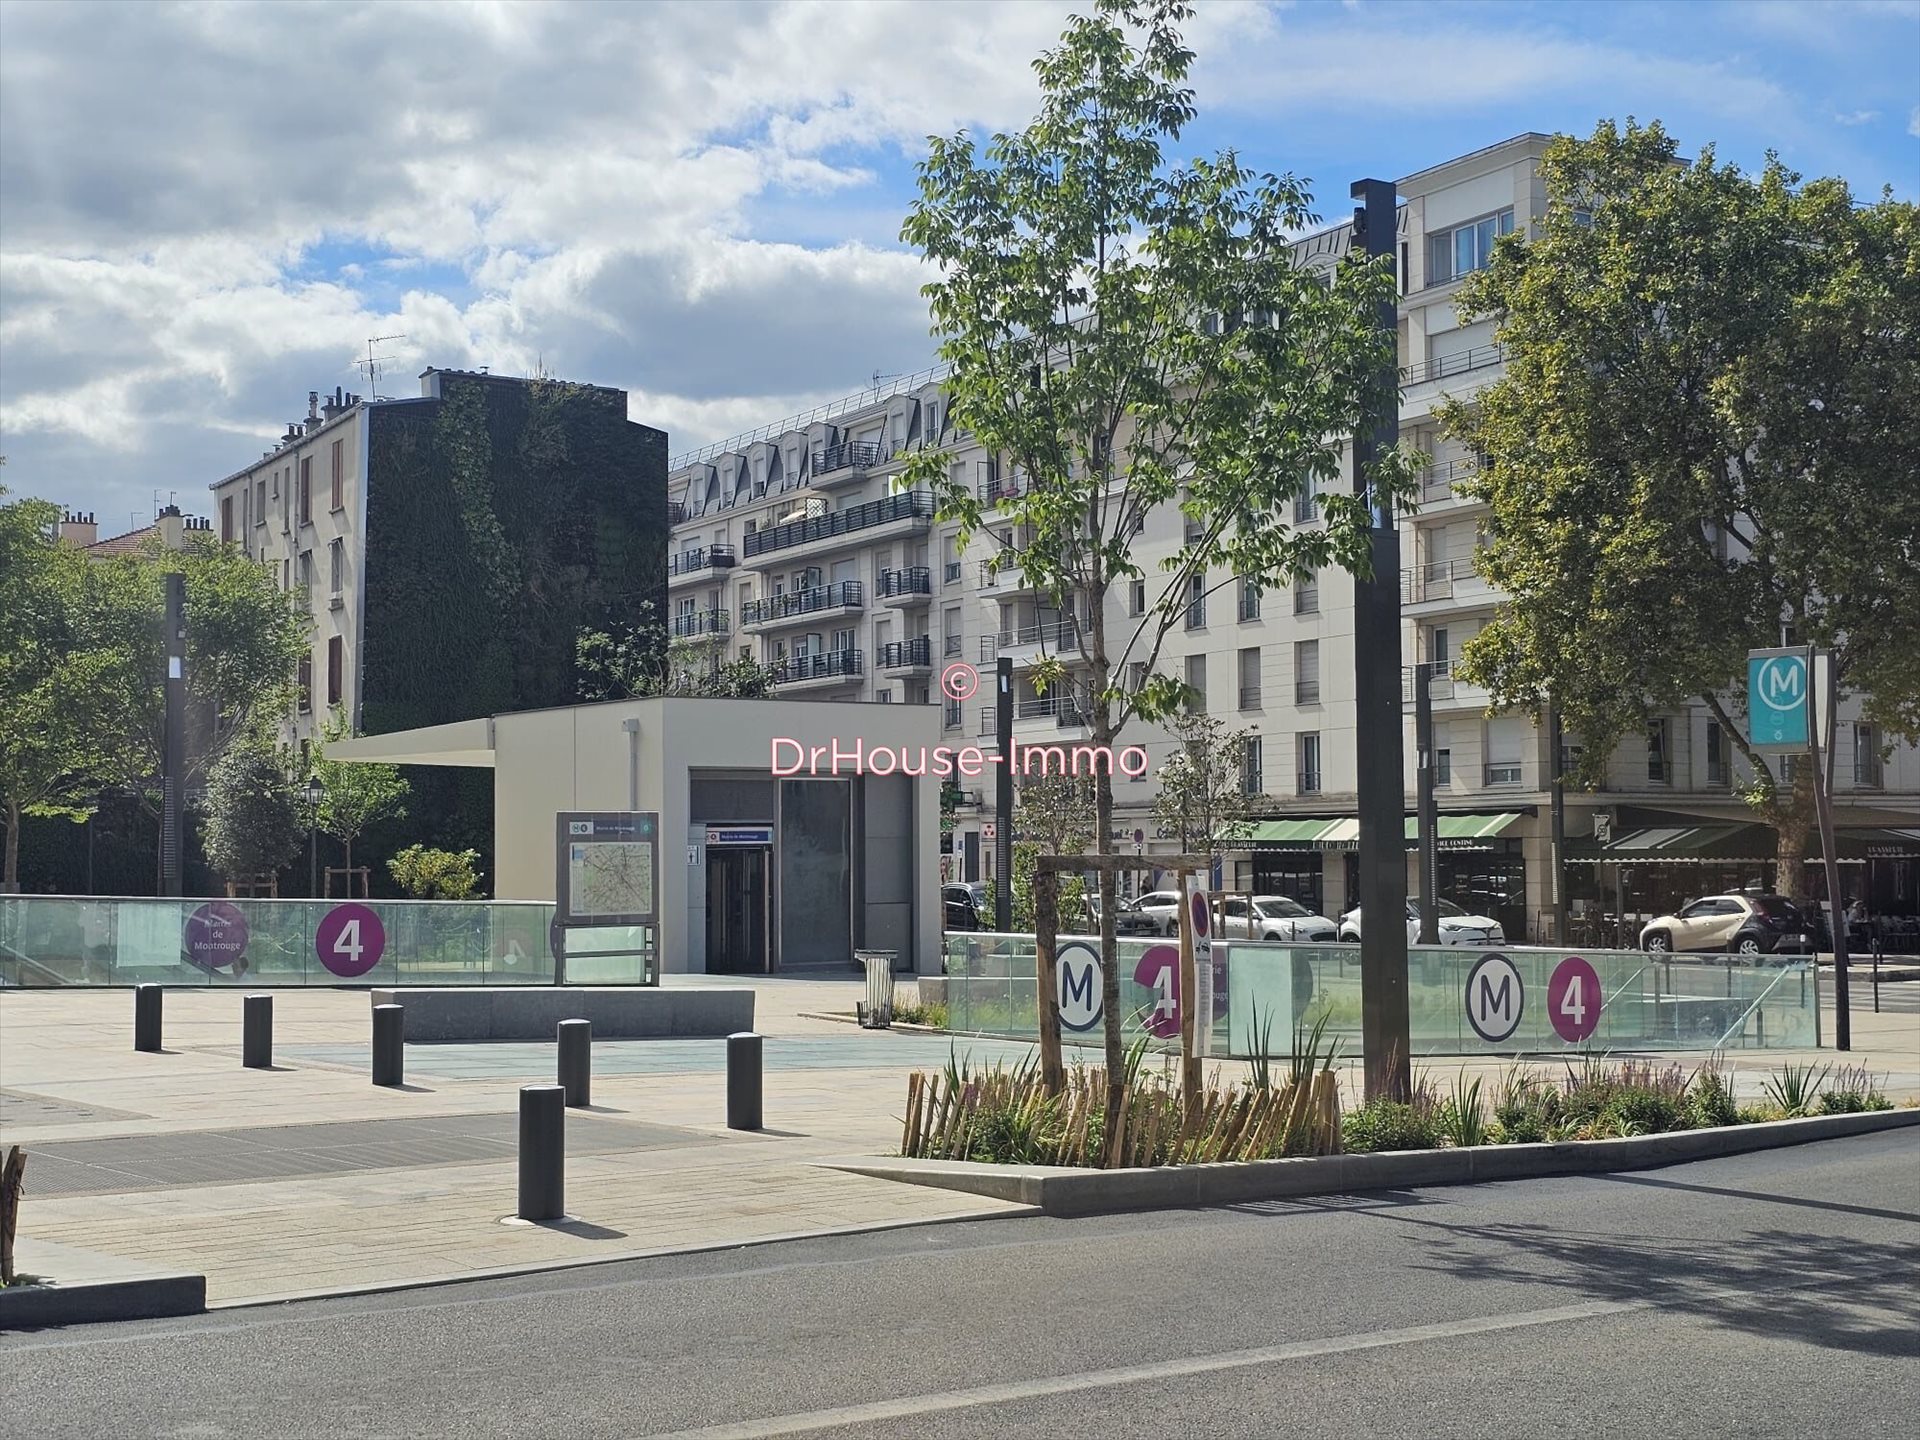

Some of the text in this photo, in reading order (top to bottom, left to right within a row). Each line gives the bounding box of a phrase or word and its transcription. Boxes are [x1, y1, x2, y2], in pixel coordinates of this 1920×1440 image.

[1770, 664, 1798, 698] M
[194, 942, 241, 951] Montrouge
[212, 930, 224, 938] de
[333, 919, 364, 962] 4
[1062, 960, 1093, 1012] M
[1153, 965, 1177, 1019] 4
[1480, 974, 1511, 1022] M
[1560, 975, 1586, 1025] 4
